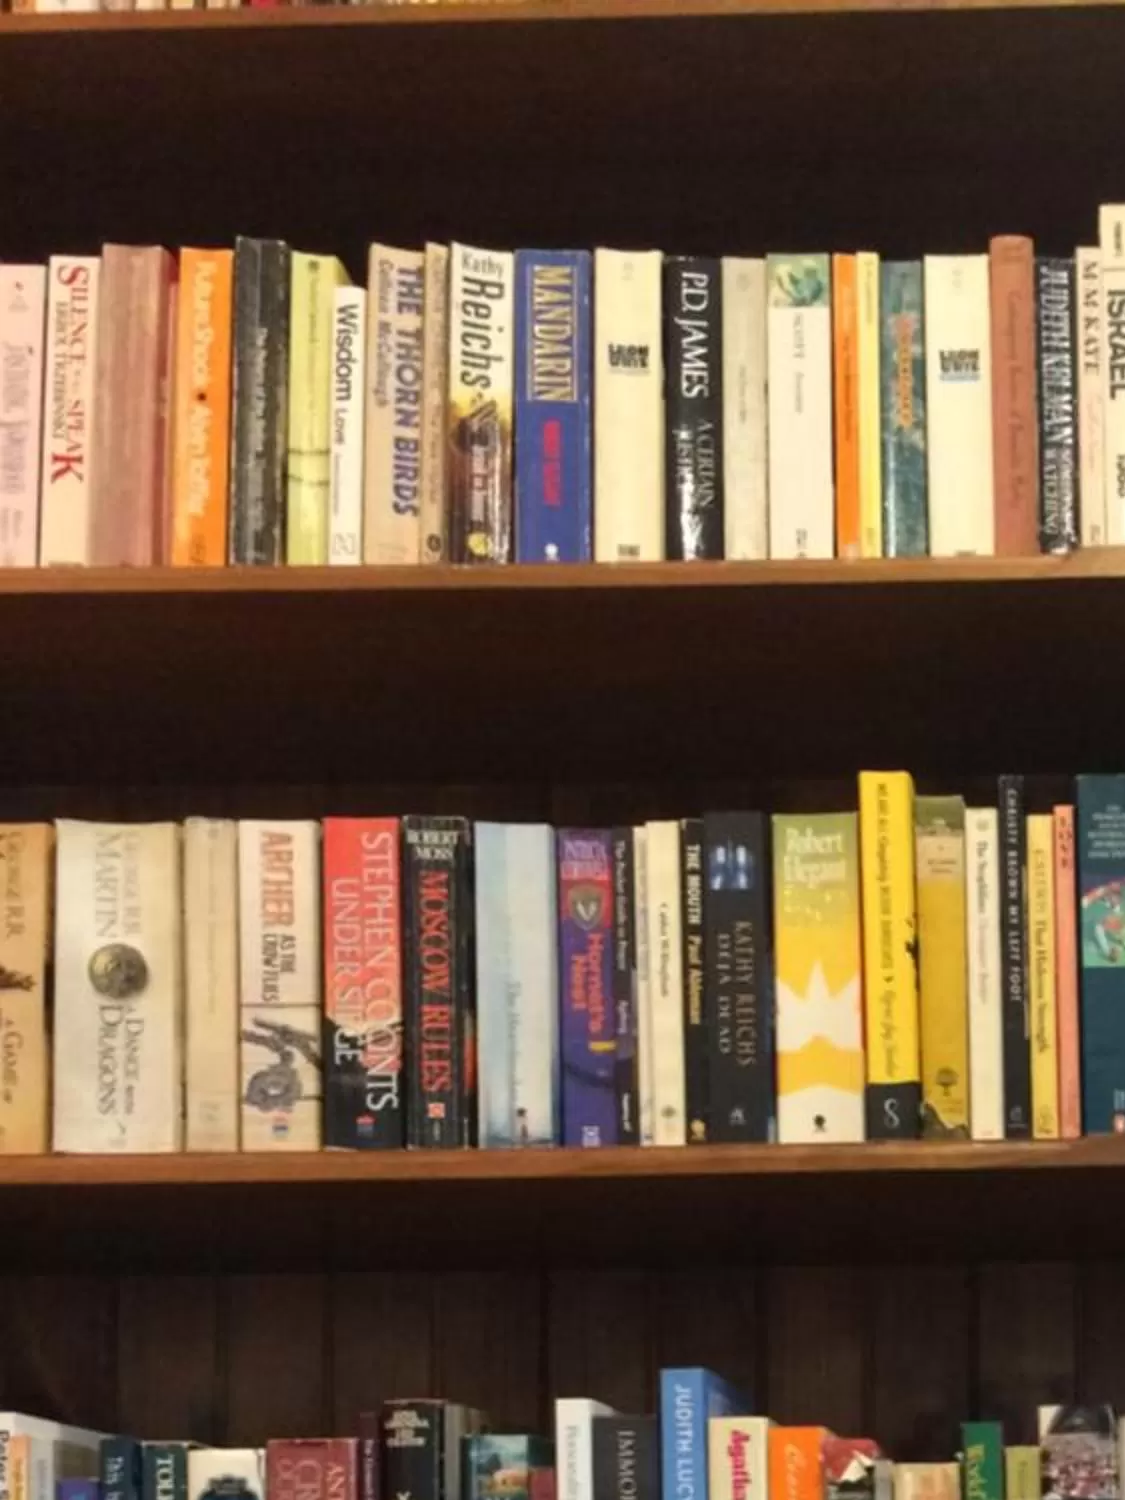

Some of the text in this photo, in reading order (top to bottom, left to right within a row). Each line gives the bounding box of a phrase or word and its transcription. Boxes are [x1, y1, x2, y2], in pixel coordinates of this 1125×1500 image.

[333, 304, 361, 445] Wisdom Love
[459, 276, 506, 390] Reichs
[531, 265, 577, 402] MANDARIN
[673, 316, 709, 399] JAMES
[391, 266, 421, 518] THE THORN BIRDS
[260, 830, 294, 930] ARCHER
[685, 844, 701, 871] THE
[686, 875, 702, 924] MOUTH
[331, 876, 361, 1066] UNDER SIEGE
[360, 831, 400, 1112] STEPHEN COONTS
[420, 869, 452, 1094] MOSCOW RULES
[734, 920, 754, 985] KATHY
[1008, 964, 1023, 1002] FOOT
[97, 1004, 125, 1116] DRAGONS
[673, 1384, 694, 1457] JUDITH
